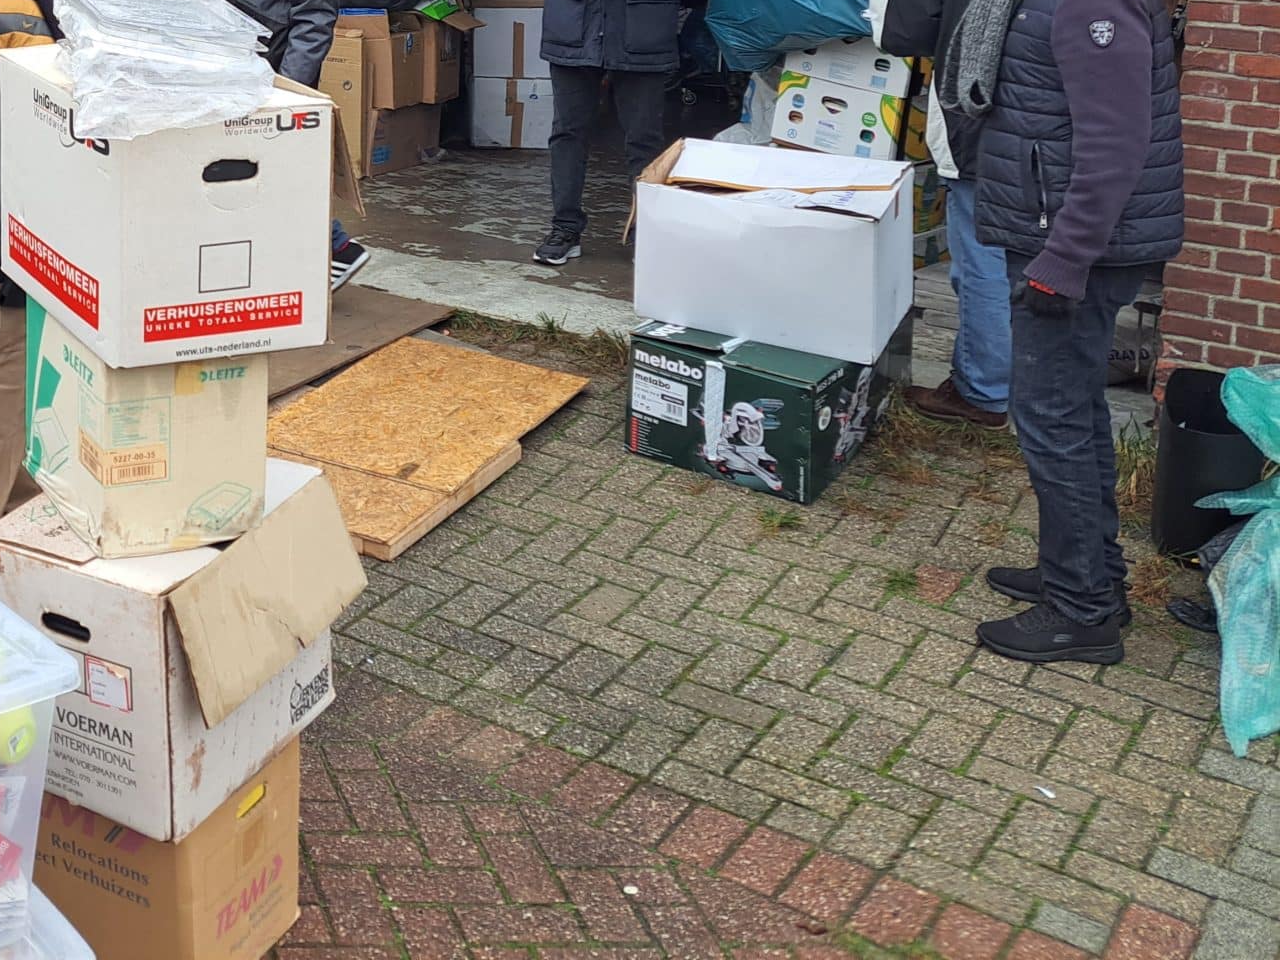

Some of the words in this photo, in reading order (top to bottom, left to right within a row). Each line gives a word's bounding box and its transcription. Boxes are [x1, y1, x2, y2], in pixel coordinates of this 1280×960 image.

[33, 87, 67, 120] UniGroup
[224, 116, 273, 128] UniGroup
[276, 111, 321, 132] UTS
[224, 126, 273, 137] Worldwide
[8, 217, 97, 299] VERHUISFENOMEEN
[34, 256, 60, 286] TOTAAL
[62, 280, 97, 315] SERVICE
[145, 320, 191, 333] UNIEKE
[198, 315, 243, 327] TOTAAL
[249, 307, 299, 321] SERVICE
[146, 293, 300, 322] VERHUISFENOMEEN
[175, 337, 272, 358] www.uts-nederland.nl
[69, 349, 95, 388] LEITZ
[209, 366, 248, 381] LEITZ
[634, 348, 704, 381] metabo
[634, 371, 671, 390] metabo
[56, 706, 133, 749] VOERMAN
[53, 731, 135, 772] INTERNATIONAL
[51, 832, 149, 887] Relocations
[62, 857, 151, 909] Verhuizers
